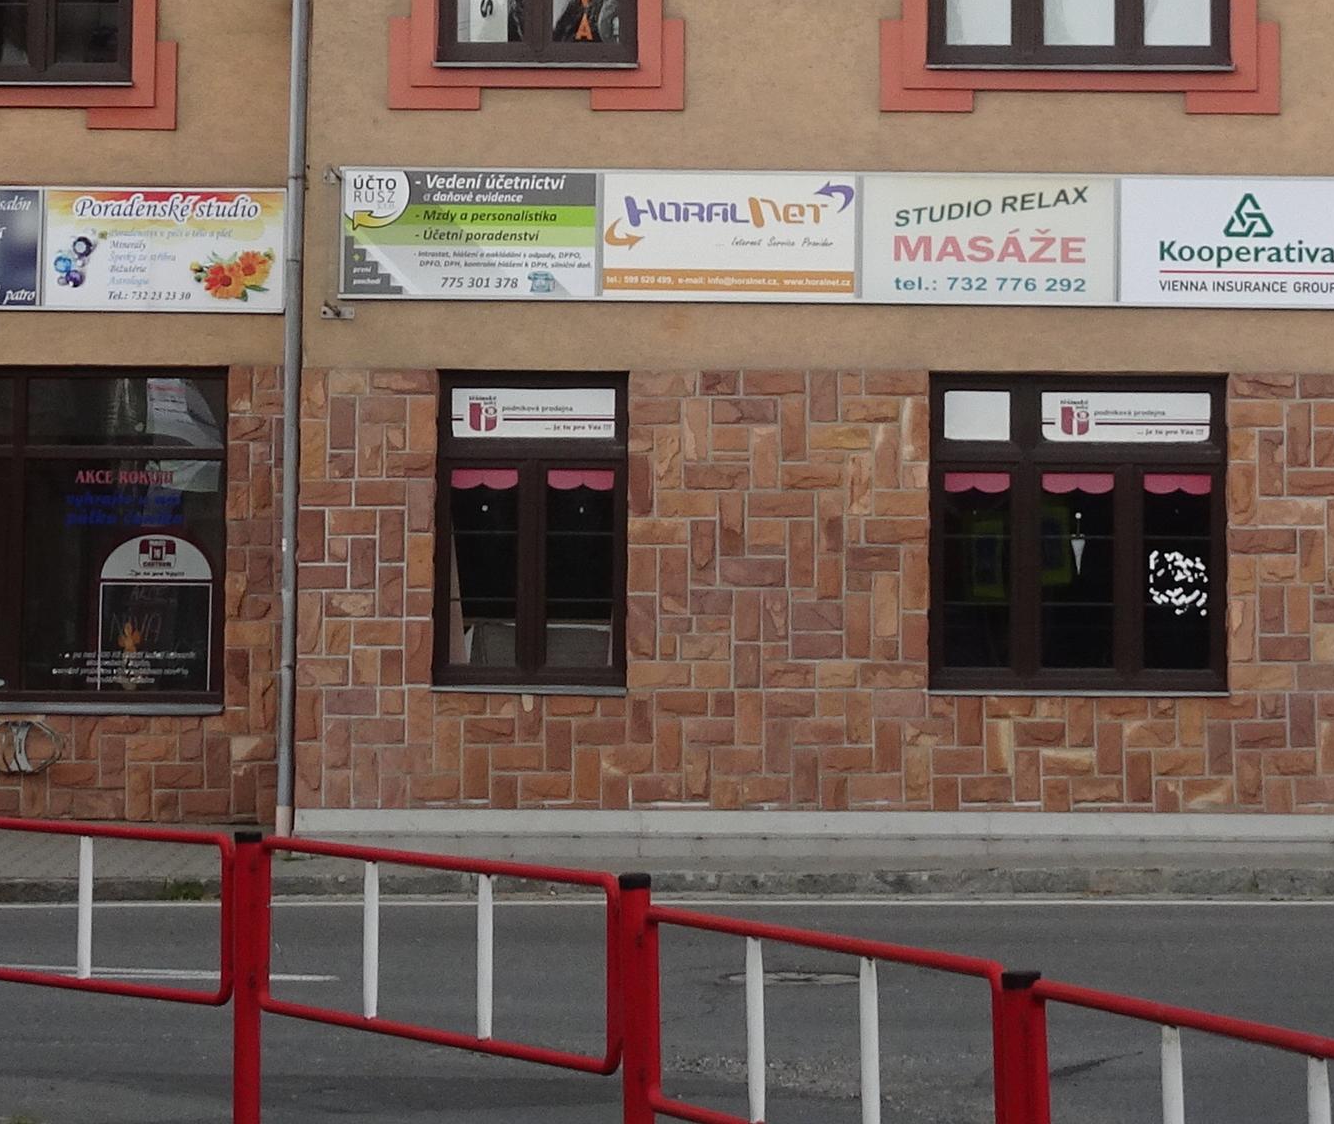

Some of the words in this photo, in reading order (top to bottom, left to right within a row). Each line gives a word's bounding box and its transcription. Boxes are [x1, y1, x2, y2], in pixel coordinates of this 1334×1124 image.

[353, 175, 396, 190] ÚČTO
[426, 175, 483, 189] Vedení
[485, 175, 566, 190] účetnictví
[353, 190, 395, 203] RUSZ
[423, 194, 430, 202] a
[433, 192, 473, 203] daňové
[475, 193, 523, 203] evidence
[75, 198, 190, 221] Poradenské
[195, 197, 259, 219] studio
[894, 199, 992, 227] STUDIO
[1001, 186, 1089, 214] RELAX
[423, 210, 456, 223] Mzdy
[460, 213, 468, 221] a
[471, 210, 557, 224] personalistika
[423, 228, 462, 241] Účetní
[465, 229, 539, 244] poradenství
[109, 240, 147, 250] Minerály
[893, 228, 1086, 263] MASÁŽE
[441, 277, 463, 288] 775
[468, 277, 490, 288] 301
[495, 277, 519, 288] 378
[894, 277, 937, 291] tel.:
[947, 277, 987, 291] 732
[996, 277, 1037, 292] 776
[1044, 278, 1085, 292] 292
[1159, 280, 1208, 292] VIENNA
[1212, 281, 1287, 293] INSURANCE
[2, 289, 36, 305] patro
[107, 291, 128, 300] Tel.:
[131, 291, 148, 300] 732
[151, 291, 162, 300] 23
[165, 291, 176, 300] 23
[179, 291, 191, 300] 30
[75, 470, 113, 484] AKCE
